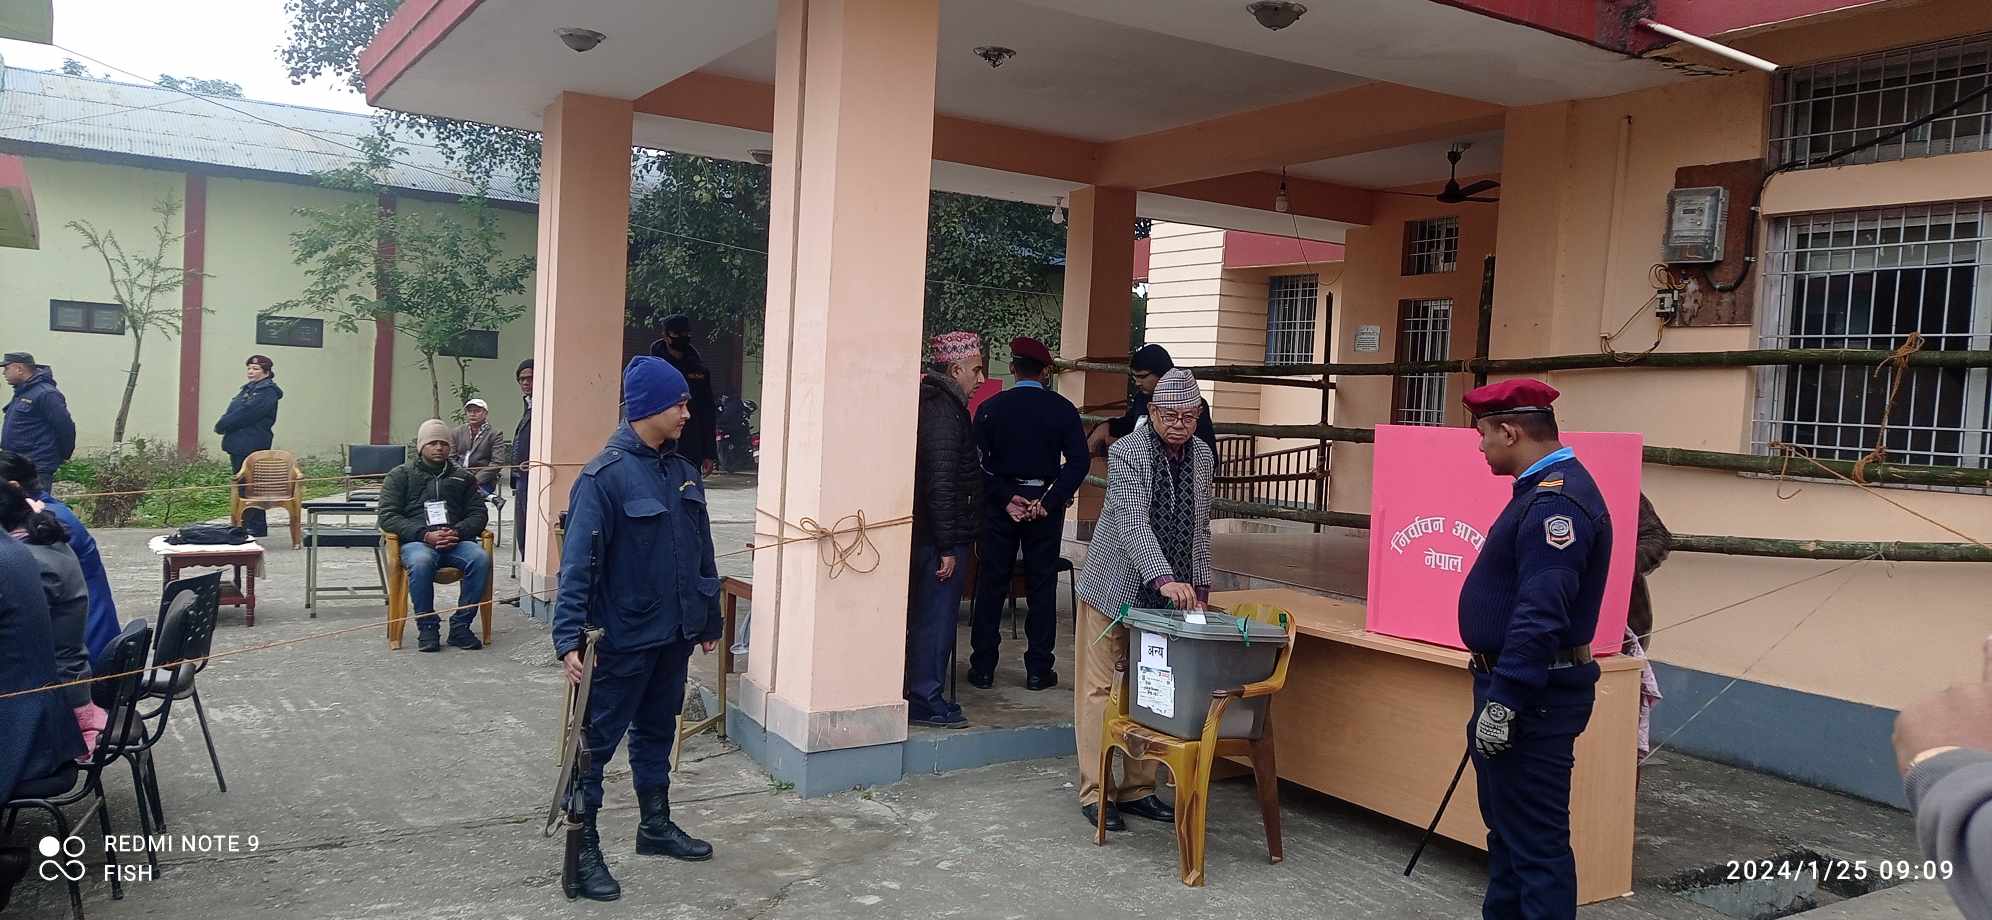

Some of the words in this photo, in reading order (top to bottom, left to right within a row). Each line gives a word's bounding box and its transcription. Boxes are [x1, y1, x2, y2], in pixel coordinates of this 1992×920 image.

[1391, 516, 1446, 554] निर्वाचन
[1452, 520, 1487, 553] आय
[1424, 548, 1463, 572] नेपाल
[1147, 645, 1165, 658] अन्य
